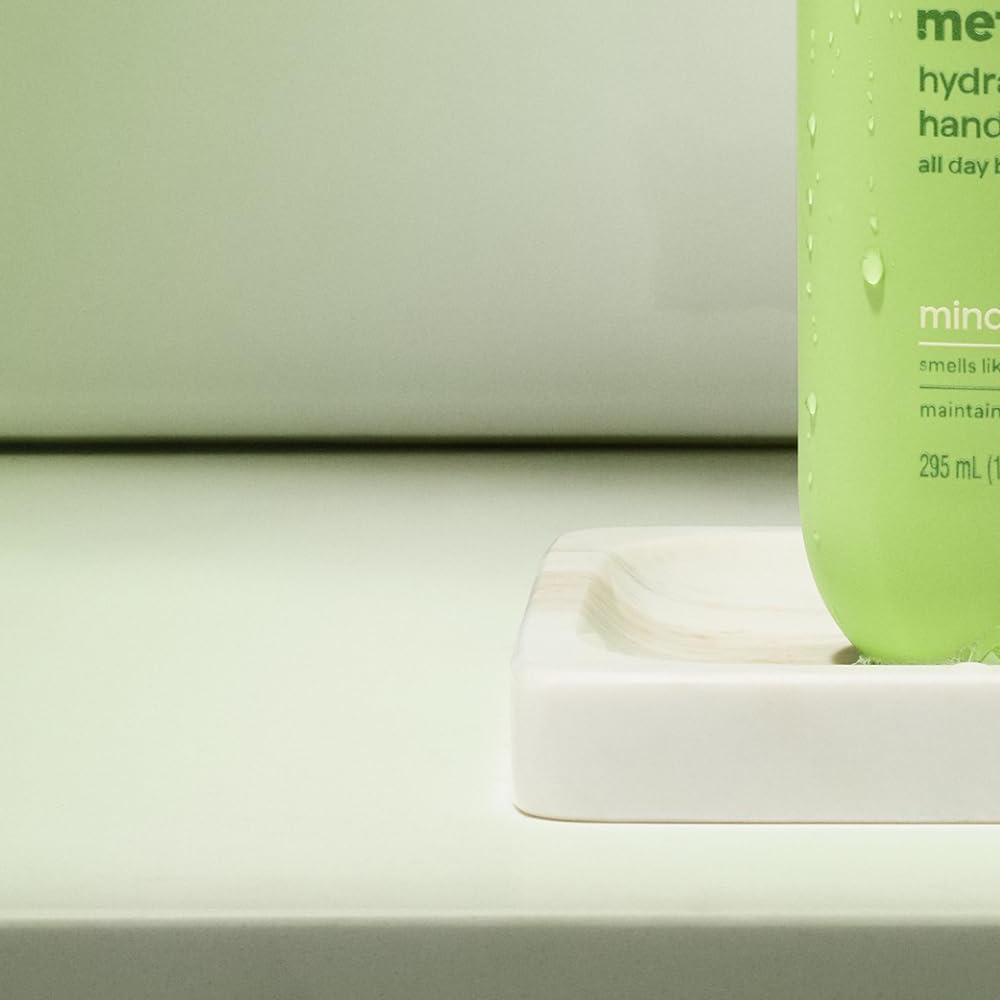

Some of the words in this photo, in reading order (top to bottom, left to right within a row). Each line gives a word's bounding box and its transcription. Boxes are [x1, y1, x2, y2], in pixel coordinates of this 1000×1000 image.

[918, 156, 944, 174] all
[948, 156, 989, 179] day
[919, 358, 977, 374] smells
[919, 453, 950, 479] 295
[956, 456, 982, 480] mL
